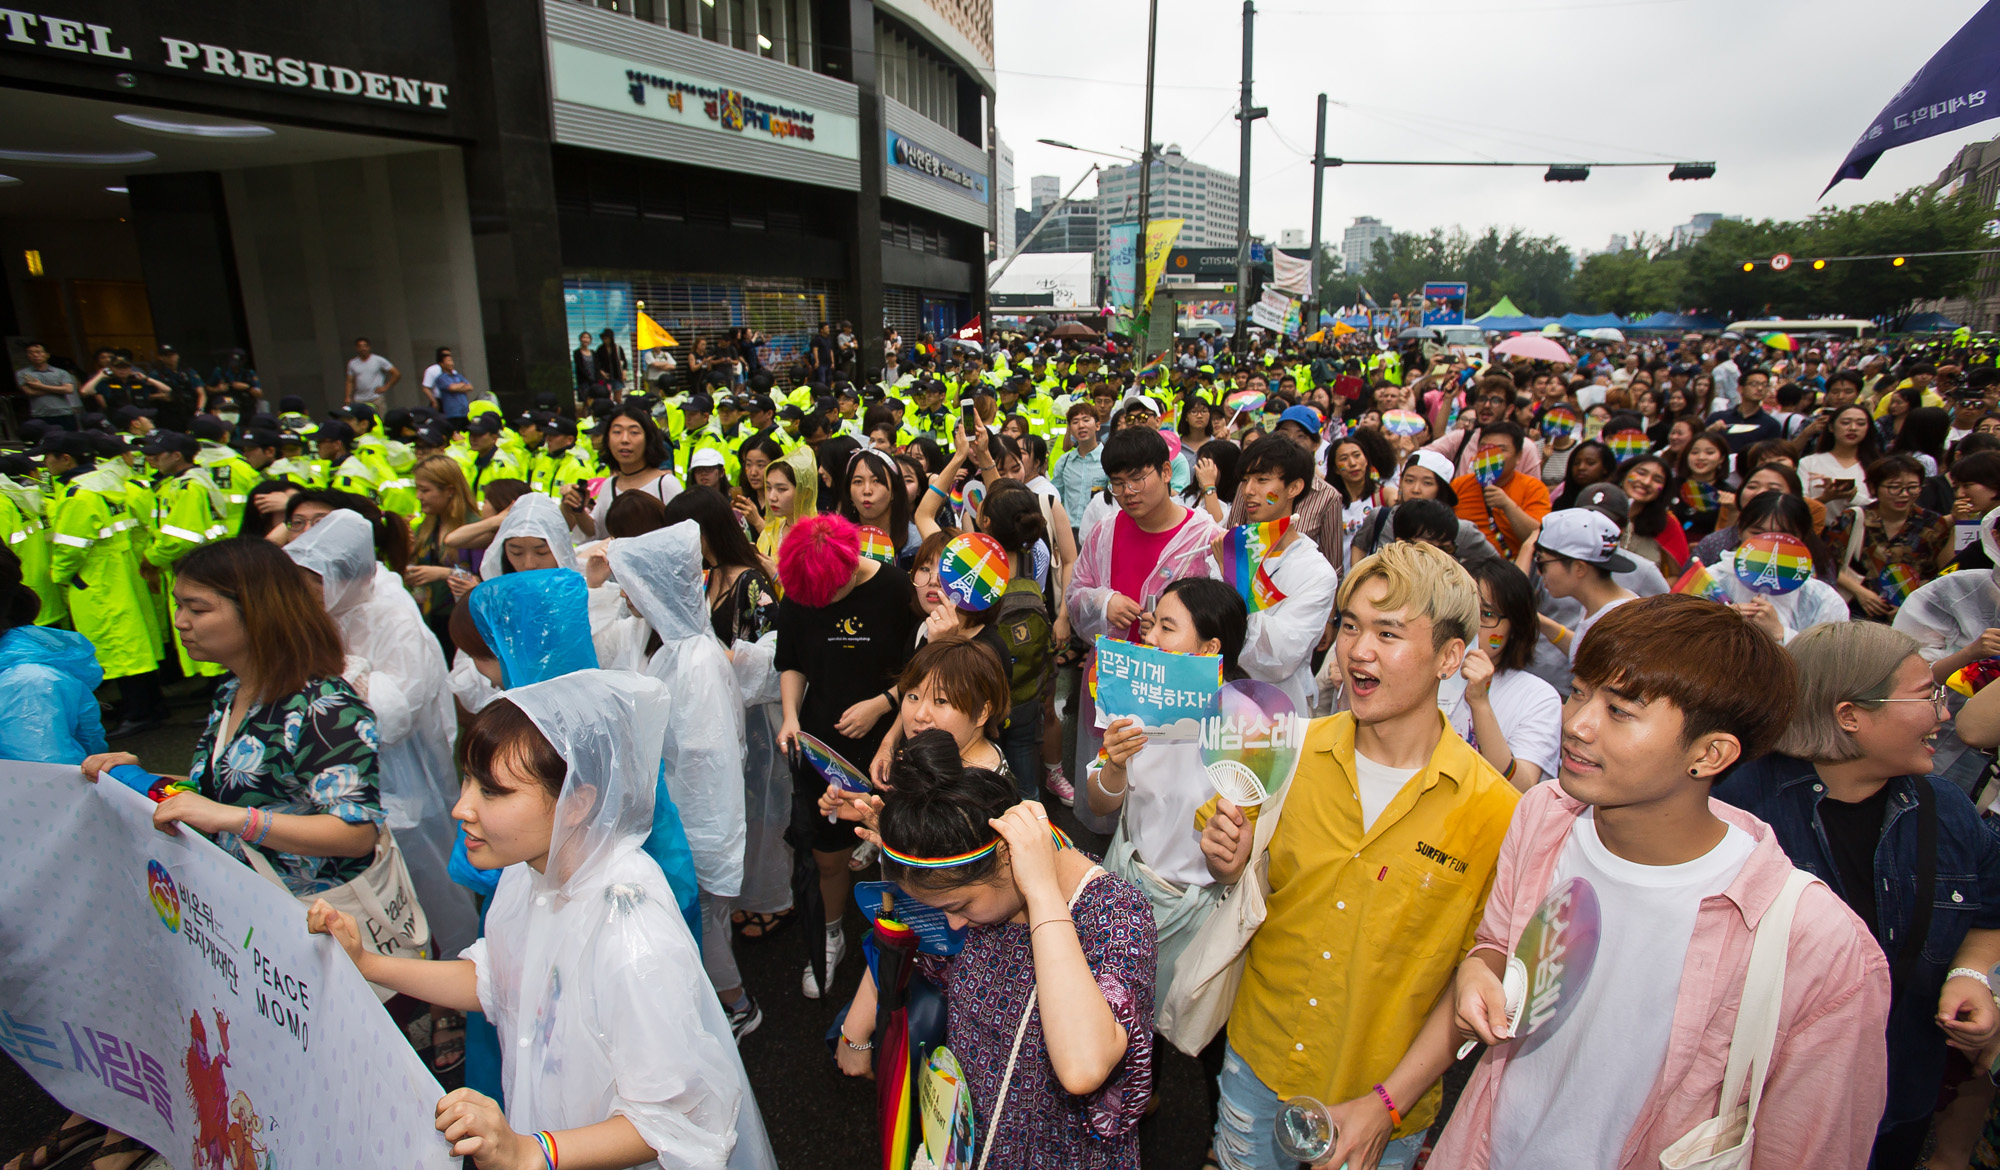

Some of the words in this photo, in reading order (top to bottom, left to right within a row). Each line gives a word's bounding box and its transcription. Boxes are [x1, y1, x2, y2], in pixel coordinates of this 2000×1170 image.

[161, 37, 448, 109] PRESIDENT
[743, 108, 815, 142] Philippines
[908, 145, 940, 177] 신한은행
[942, 537, 971, 573] FRANCE
[1737, 543, 1756, 577] FRANCE
[1101, 650, 1166, 684] 끈질기게
[1131, 680, 1212, 710] 행복하자!
[1198, 711, 1298, 751] 새삼스레
[1450, 860, 1469, 874] FUN
[179, 882, 215, 933] 비온뒤
[184, 918, 239, 996] 무지개재단
[254, 947, 310, 1012] PEACE
[256, 987, 309, 1052] MOMO
[62, 1020, 175, 1134] 사람들
